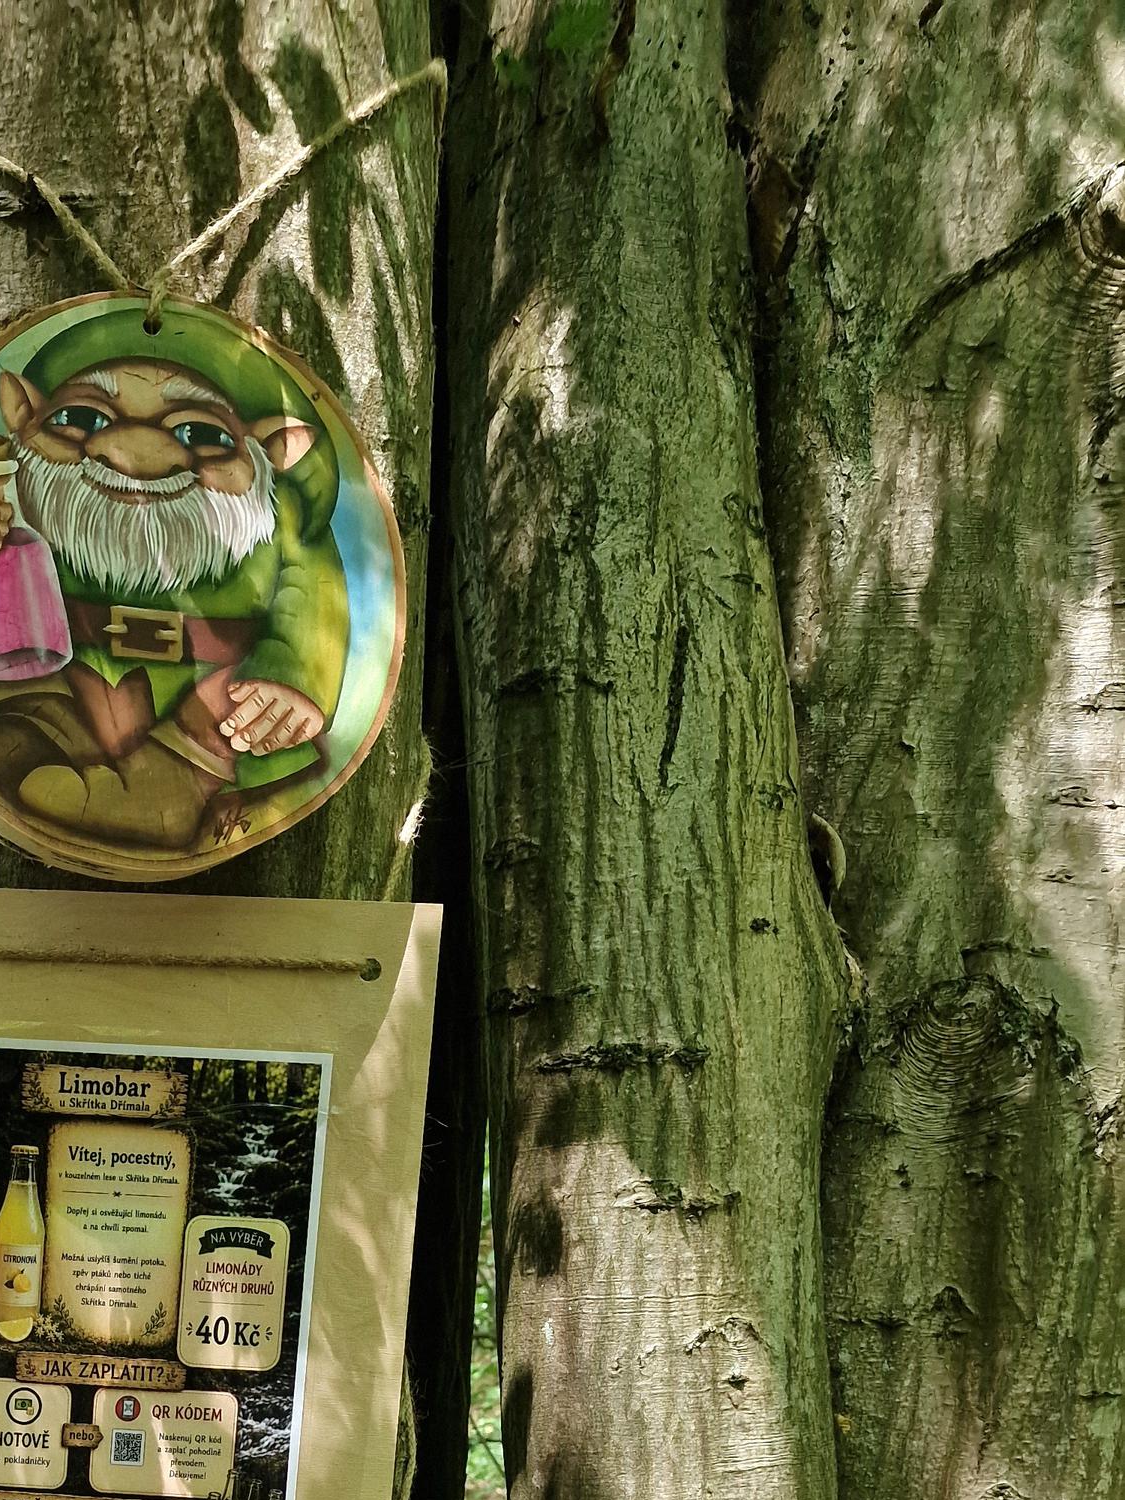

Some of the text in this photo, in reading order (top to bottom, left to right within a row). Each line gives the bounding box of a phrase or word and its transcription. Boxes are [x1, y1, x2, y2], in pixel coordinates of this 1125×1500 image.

[58, 1071, 151, 1098] Limobar
[69, 1097, 107, 1110] Skřítka
[110, 1099, 150, 1112] Dřímala
[68, 1146, 176, 1170] Vítej, pocestný,
[65, 1171, 101, 1180] kouzelném
[103, 1173, 116, 1182] lese
[66, 1206, 166, 1220] Dopřej si osvěžující limonádu
[101, 1223, 119, 1232] chvíli
[122, 1225, 149, 1234] zpomal.
[210, 1230, 264, 1247] NA VÝBĚR
[3, 1254, 37, 1264] CITRONOVÁ
[61, 1253, 84, 1262] Možná
[113, 1255, 139, 1265] šumění
[205, 1260, 263, 1276] LIMONÁDY
[72, 1269, 151, 1280] zpěv ptáků nebo tiché
[75, 1283, 147, 1295] chrápání samotného
[192, 1277, 275, 1295] RŮZNÝCH DRUHŮ
[81, 1297, 139, 1309] Skřítka Dřímala.
[195, 1315, 261, 1347] 40 Kč
[41, 1360, 165, 1382] JAK ZAPLATIT?
[152, 1403, 222, 1422] QR KÓDEM
[69, 1430, 94, 1441] nebo
[159, 1432, 222, 1444] Naskenuj QR kód
[165, 1446, 187, 1455] zaplať
[189, 1447, 221, 1456] pohodlně
[4, 1456, 51, 1468] pokladničky
[170, 1458, 207, 1467] převodem.
[169, 1470, 207, 1480] Děkujeme!
